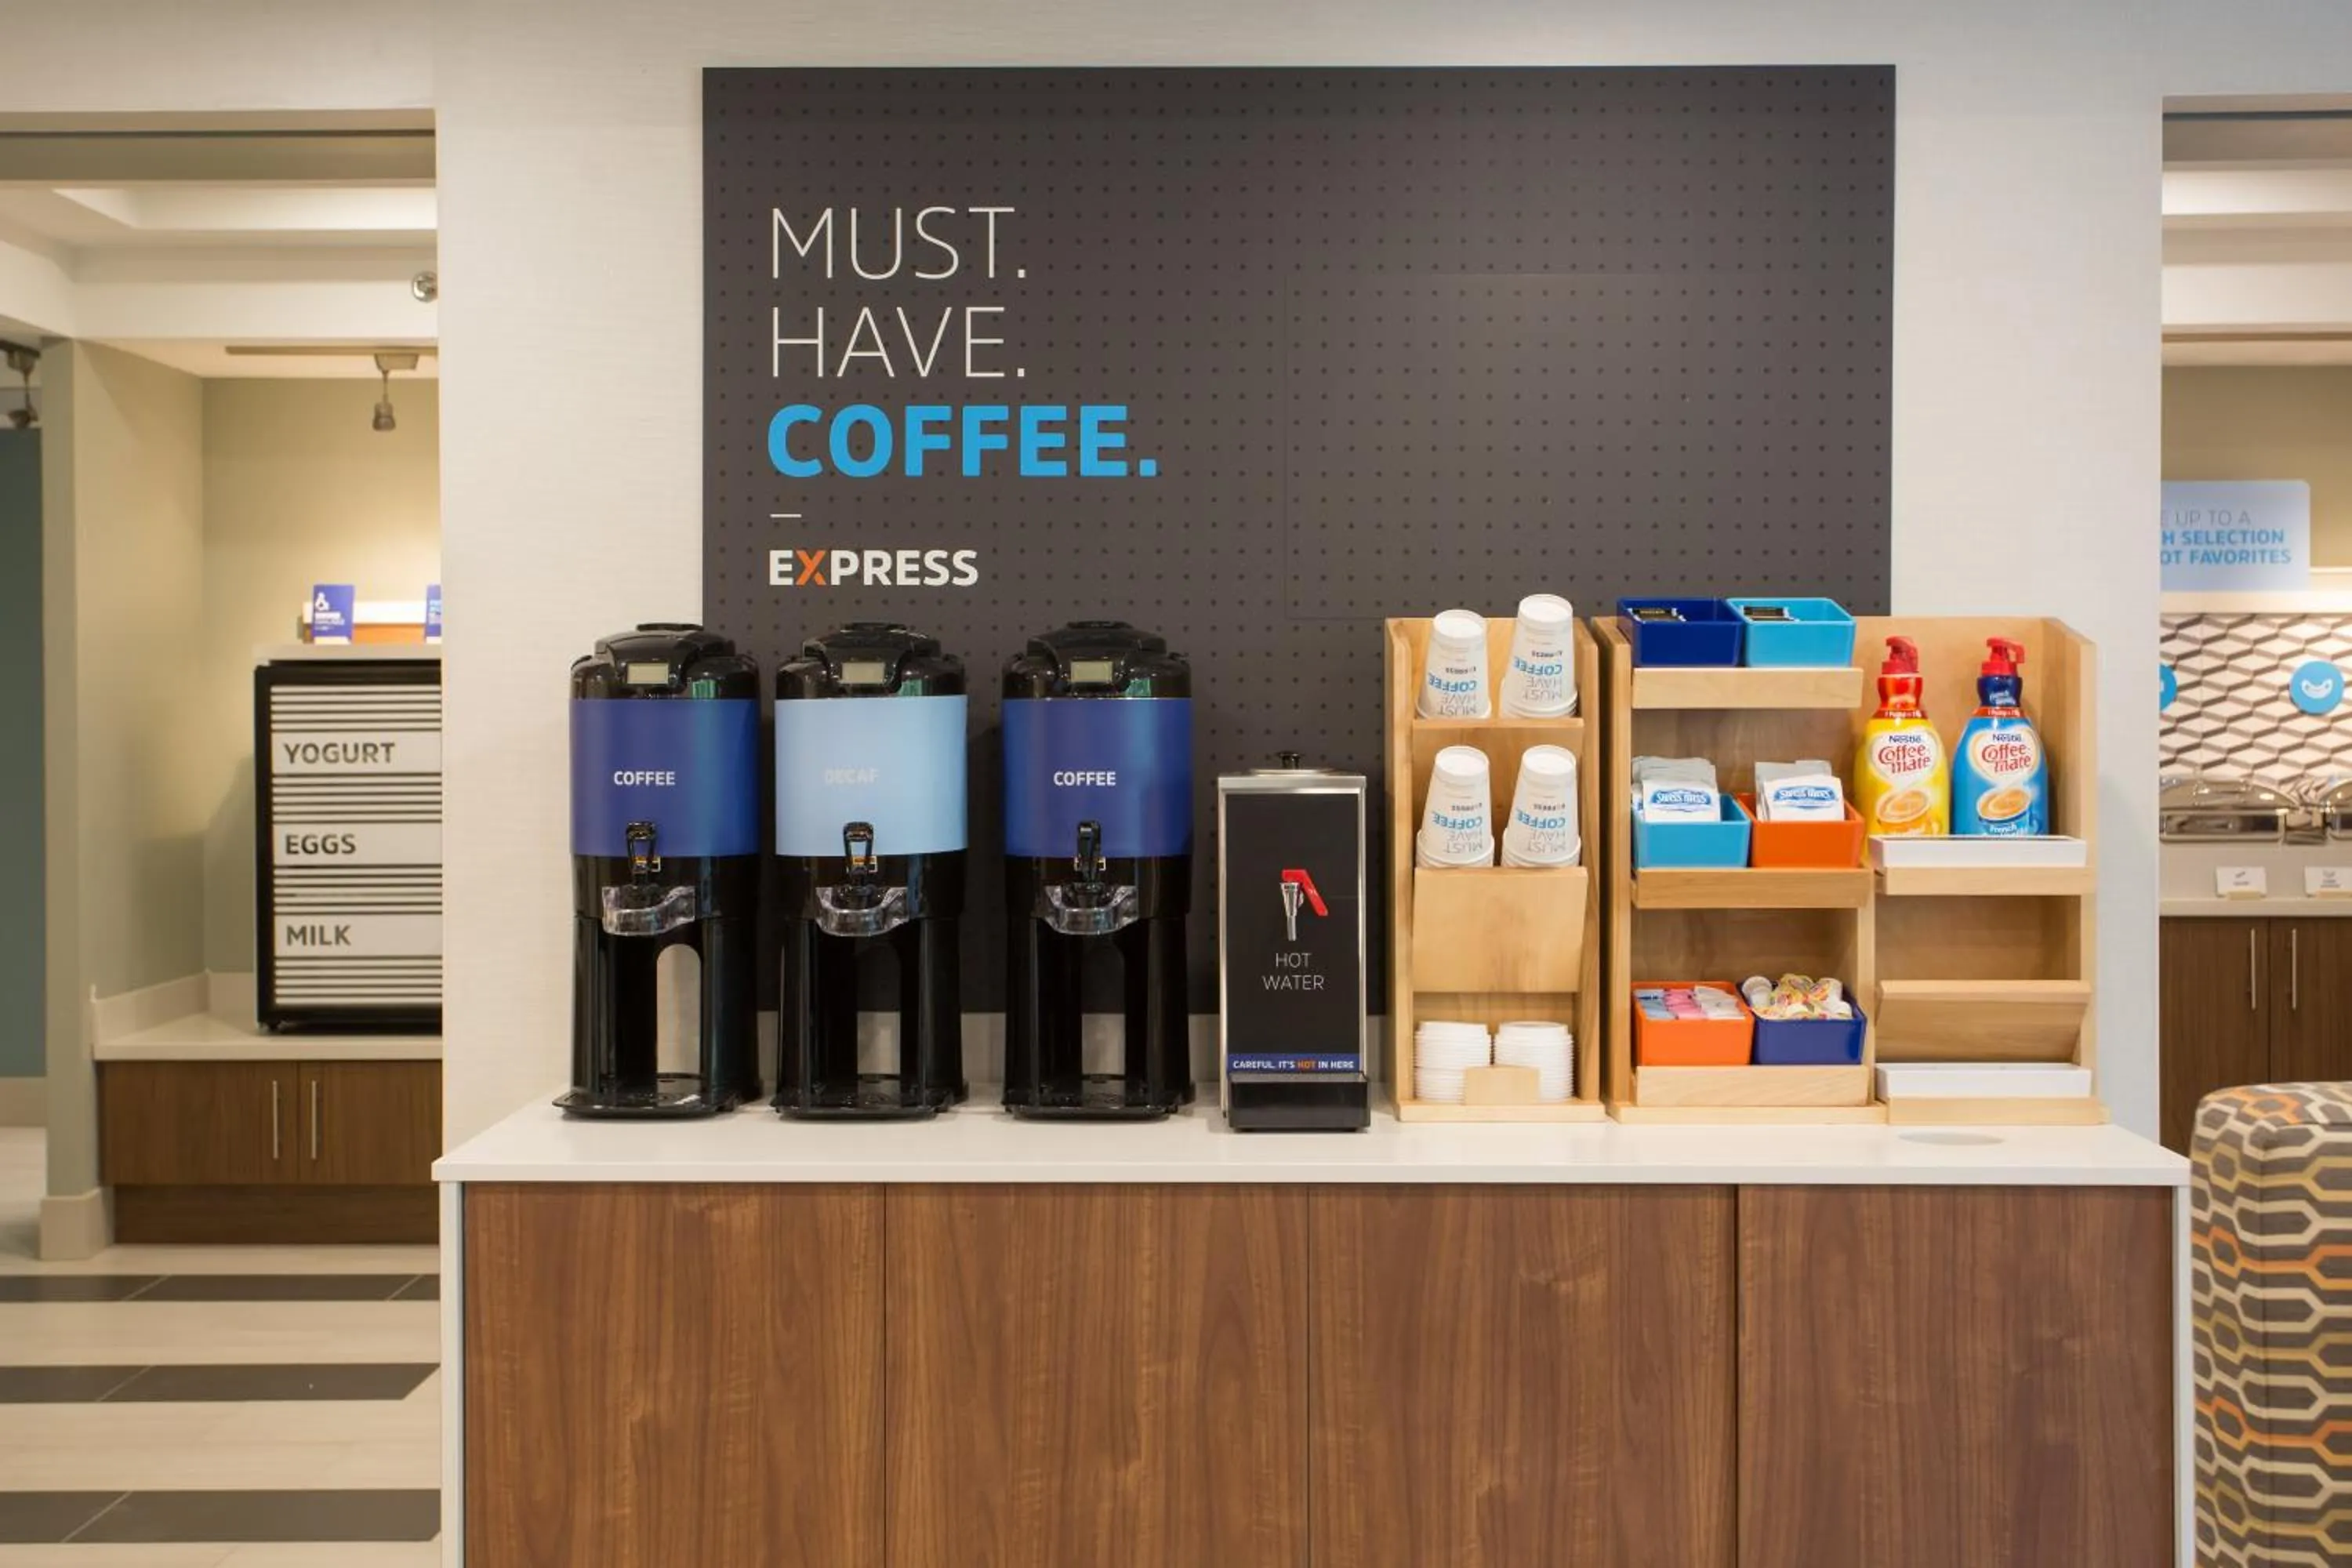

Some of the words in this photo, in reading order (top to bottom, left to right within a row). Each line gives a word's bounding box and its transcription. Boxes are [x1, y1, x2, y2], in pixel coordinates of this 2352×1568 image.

[772, 206, 1026, 280] MUST.
[772, 306, 1025, 378] HAVE.
[768, 404, 1157, 477] COFFEE.
[2175, 510, 2201, 525] UP
[2208, 510, 2232, 525] TO
[2238, 509, 2252, 524] A
[2182, 529, 2285, 546] SELECTION
[2190, 550, 2292, 564] FAVORITES
[769, 550, 979, 586] EXPRESS
[283, 742, 396, 764] YOGURT
[1878, 744, 1927, 764] Coffee
[1981, 743, 2027, 764] Coffee
[1890, 756, 1931, 775] mate
[1994, 755, 2032, 774] mate
[613, 771, 677, 787] COFFEE
[824, 768, 880, 786] DECAF
[1052, 771, 1117, 787] COFFEE
[285, 834, 356, 855] EGGS
[285, 926, 350, 946] MILK
[1276, 953, 1312, 968] HOT
[1262, 975, 1324, 990] WATER
[1298, 1060, 1316, 1069] HOT
[1318, 1060, 1329, 1069] IN
[1330, 1060, 1355, 1069] HERE
